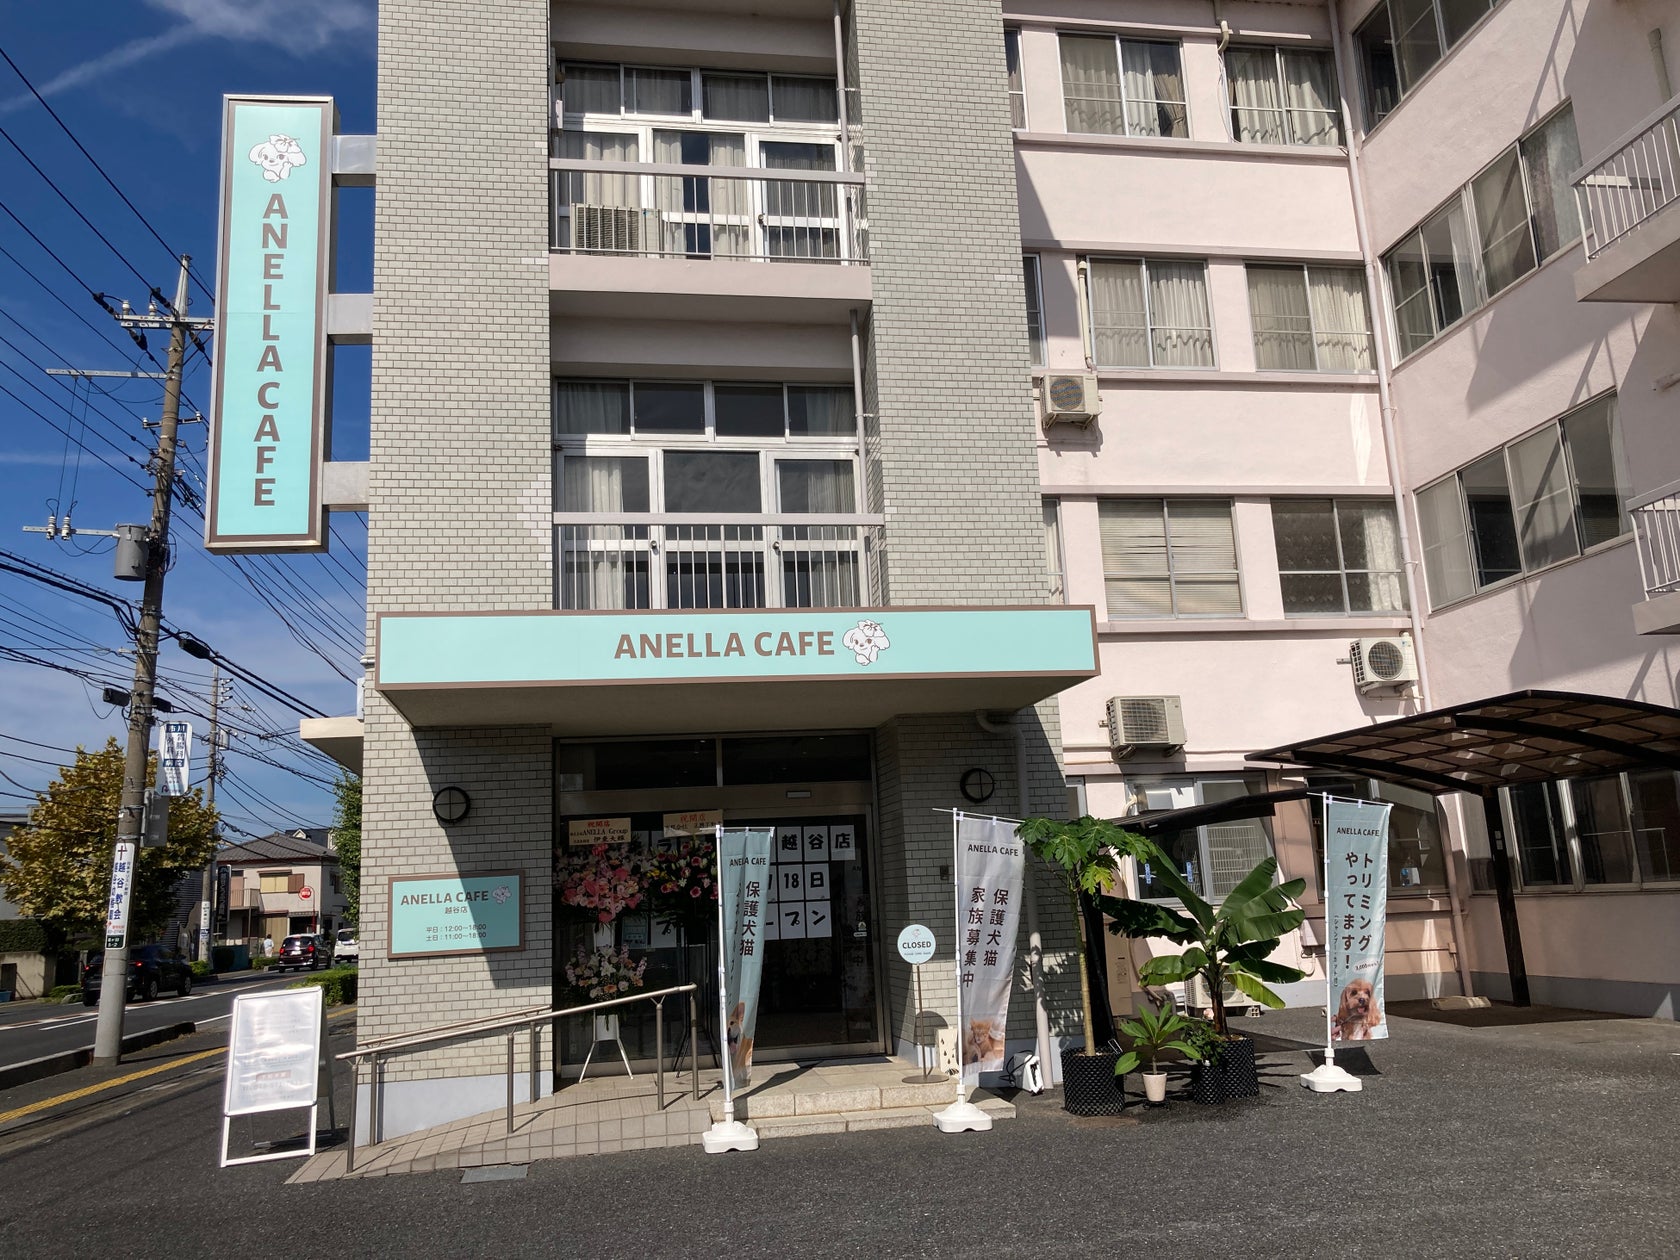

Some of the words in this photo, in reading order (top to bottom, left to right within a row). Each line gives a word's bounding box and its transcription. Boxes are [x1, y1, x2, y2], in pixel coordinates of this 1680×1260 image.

[256, 193, 288, 373] ANELLA
[253, 381, 281, 506] CAFE
[614, 632, 746, 659] ANELLA
[754, 631, 835, 656] CAFE
[781, 832, 851, 851] 越谷店
[1336, 827, 1362, 836] ANELLA
[1363, 828, 1380, 837] CAFE
[968, 844, 998, 854] ANELLA
[999, 846, 1019, 857] CAFE
[729, 857, 750, 867] ANELA
[751, 857, 766, 866] CAFE
[768, 871, 825, 889] 18日
[401, 892, 453, 905] ANELLA
[456, 890, 489, 903] CAFE
[1358, 853, 1373, 952] トリミング
[445, 906, 468, 915] 越谷店
[739, 880, 760, 956] 保護犬猫
[983, 888, 1009, 967] 保護犬猫
[902, 940, 932, 950] CLOSED
[962, 887, 985, 988] 家族募集中
